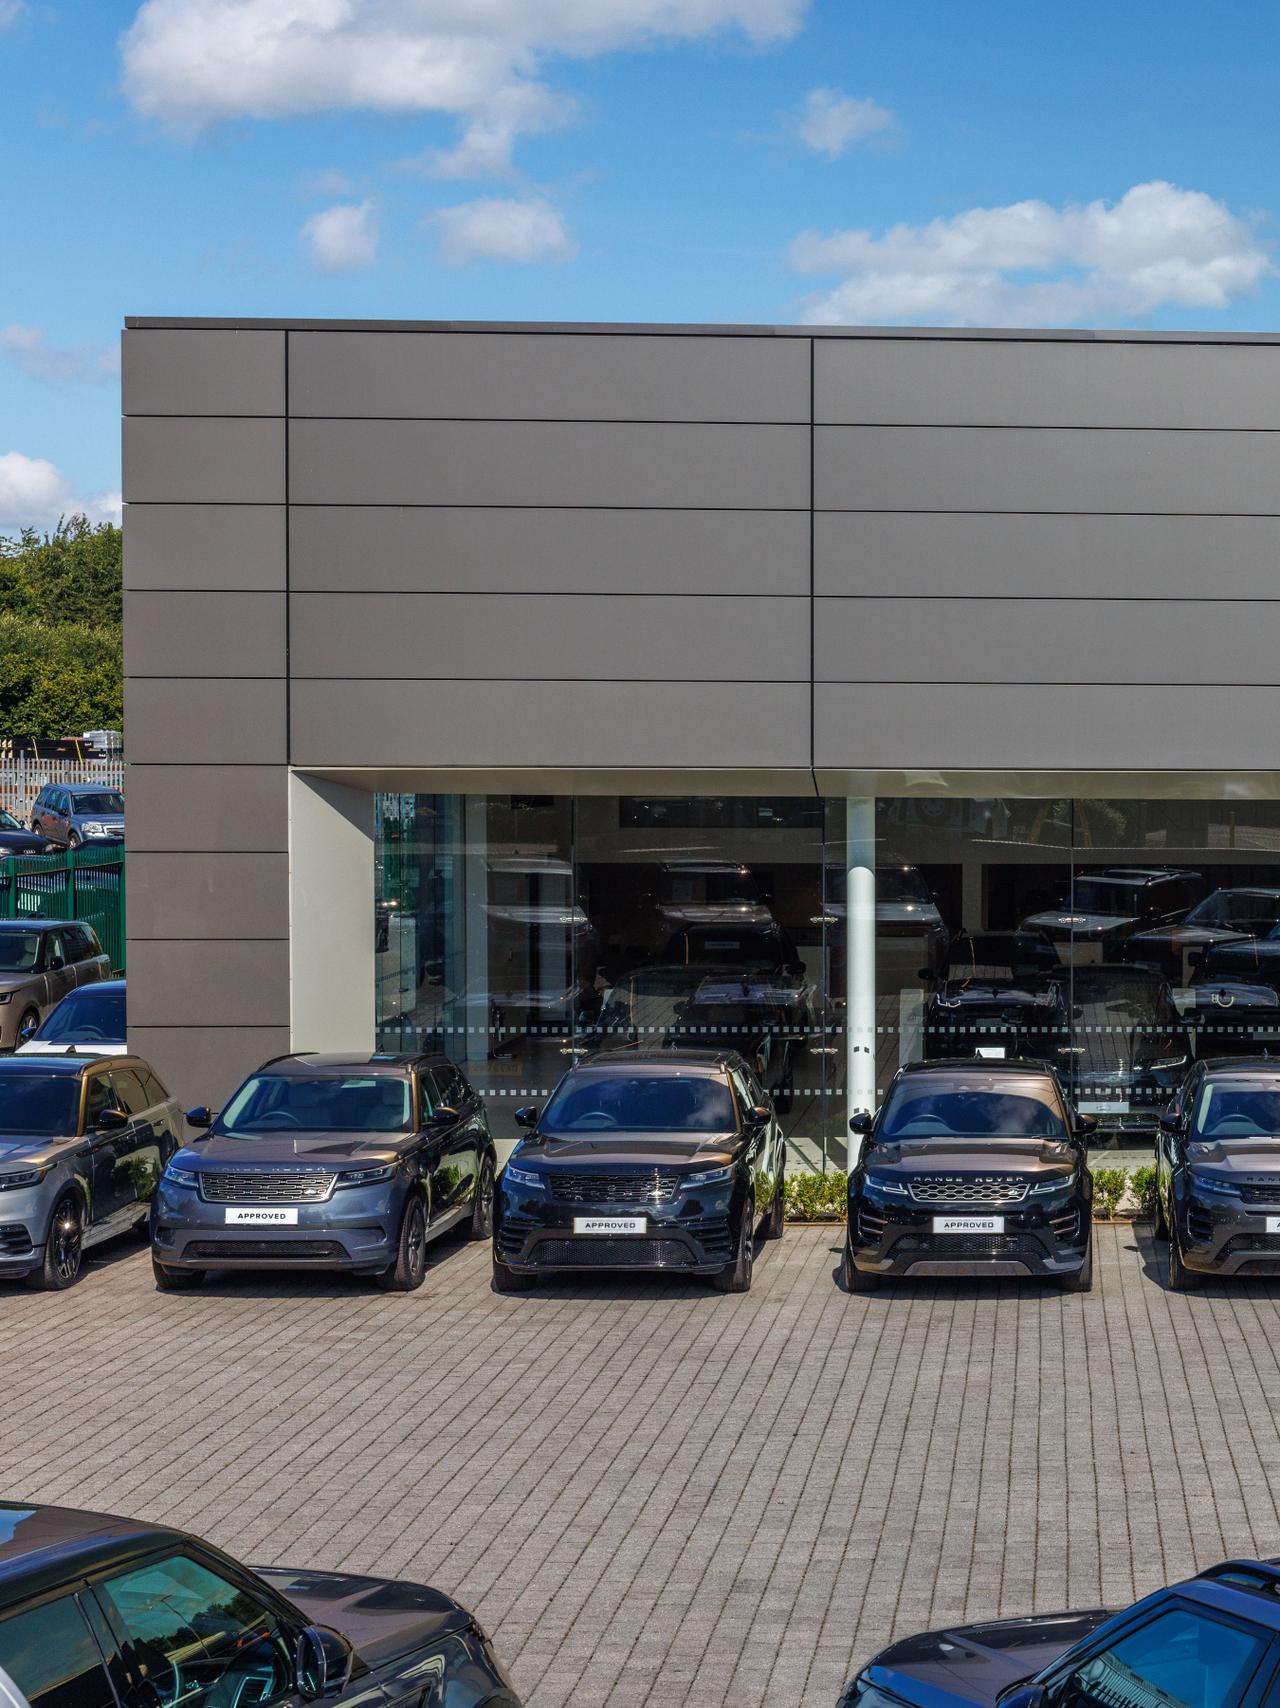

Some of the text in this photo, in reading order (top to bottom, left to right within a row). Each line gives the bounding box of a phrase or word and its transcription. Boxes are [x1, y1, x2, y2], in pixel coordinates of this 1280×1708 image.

[237, 1212, 287, 1220] APPROVED
[584, 1221, 637, 1229] APPROVED
[943, 1220, 995, 1229] APPROVED
